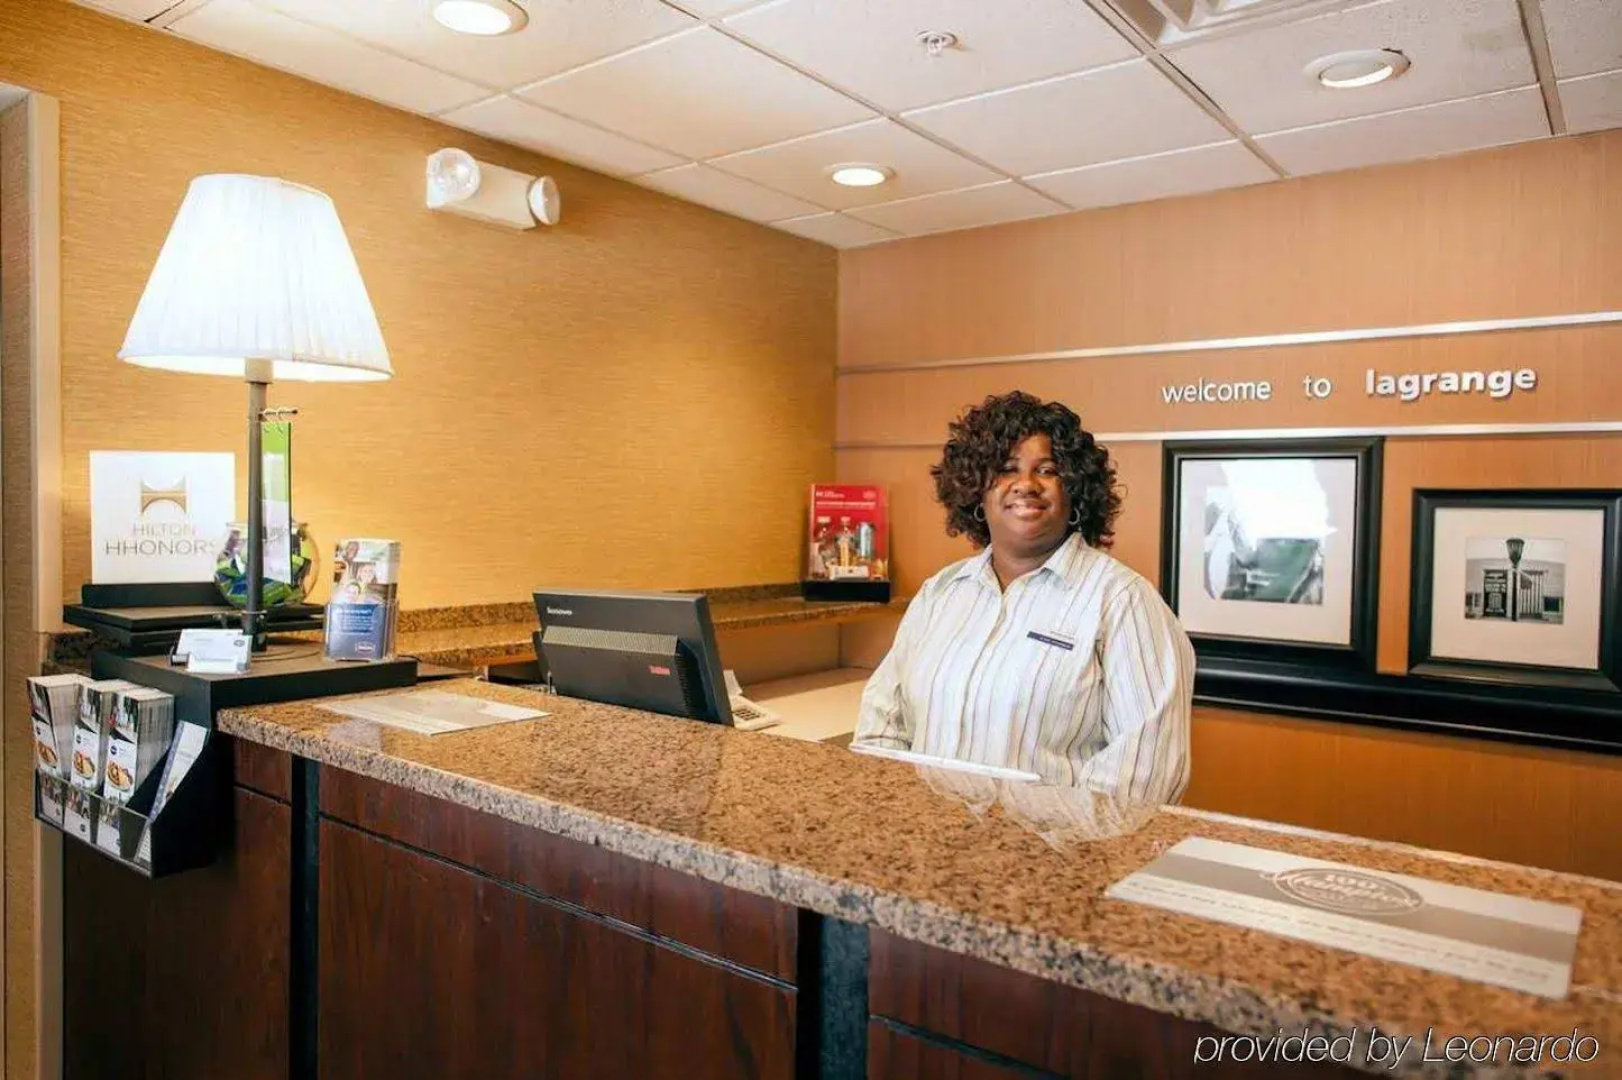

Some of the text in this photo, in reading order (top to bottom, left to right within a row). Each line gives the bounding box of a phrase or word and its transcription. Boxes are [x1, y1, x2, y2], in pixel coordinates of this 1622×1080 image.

[1162, 367, 1539, 403] welcome to lagrange
[132, 522, 197, 536] HILTON
